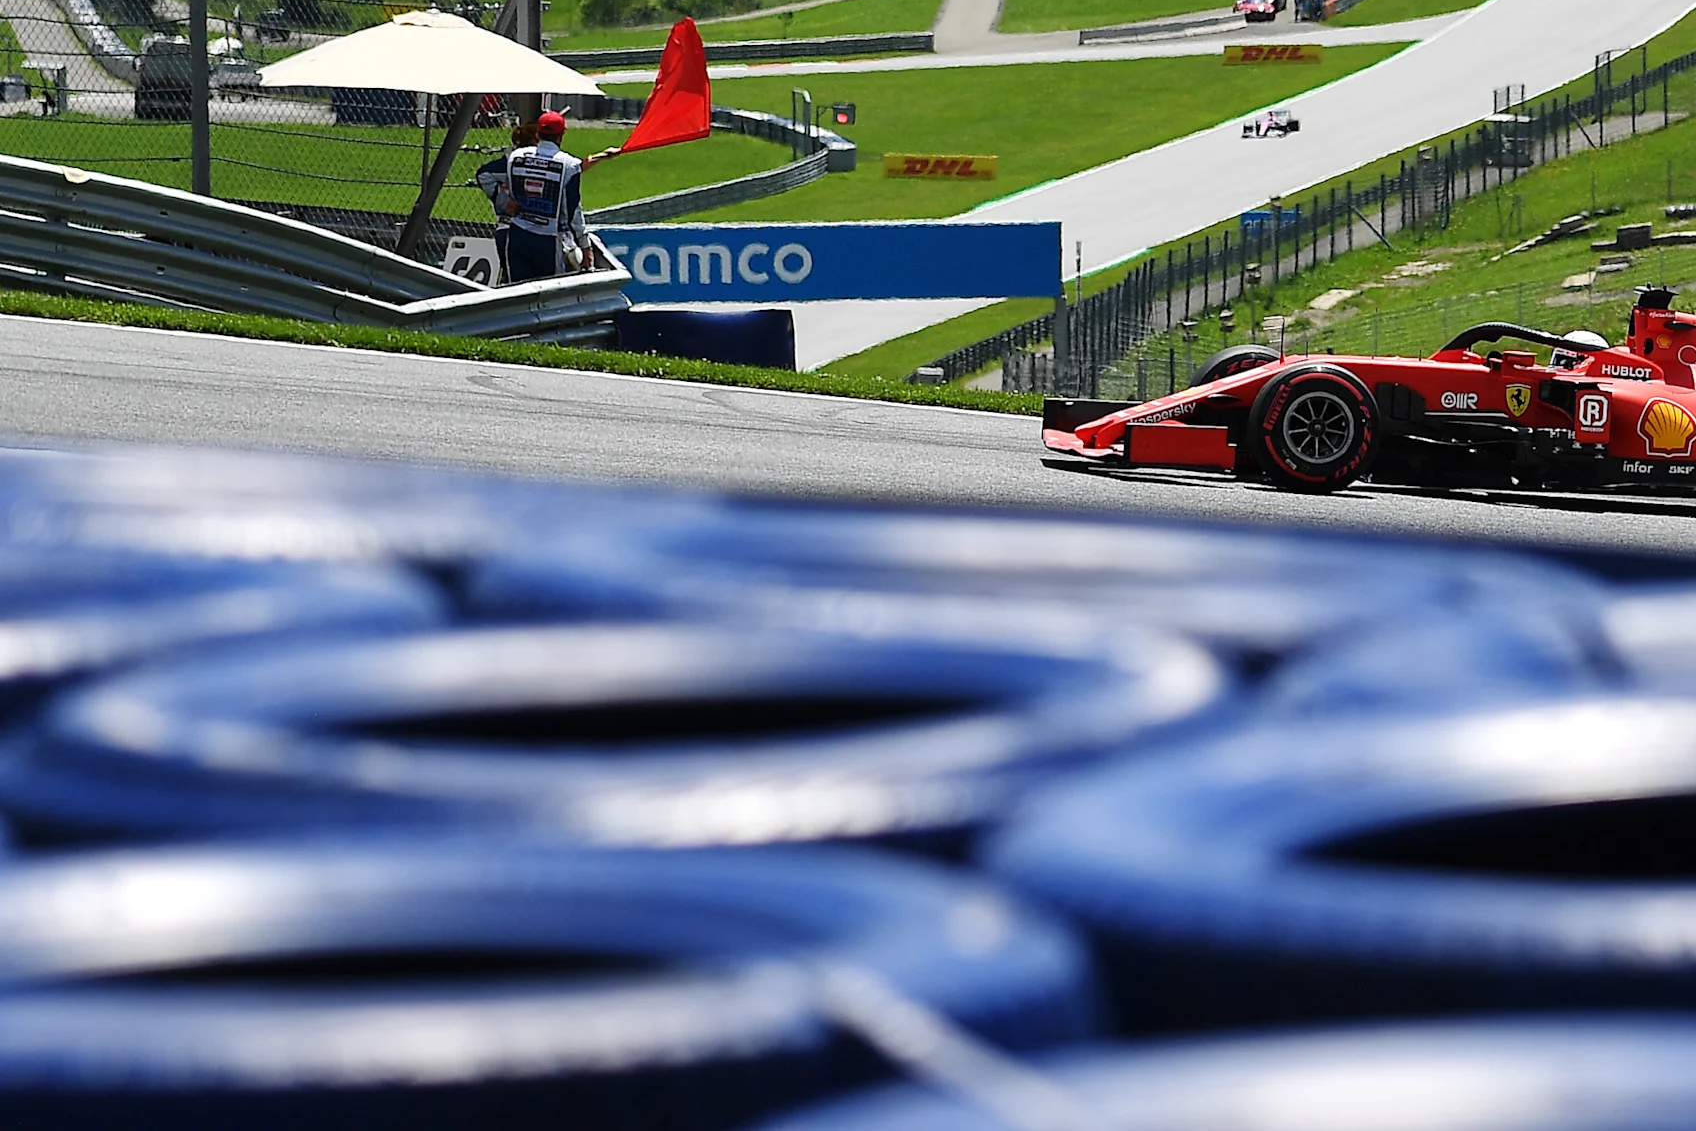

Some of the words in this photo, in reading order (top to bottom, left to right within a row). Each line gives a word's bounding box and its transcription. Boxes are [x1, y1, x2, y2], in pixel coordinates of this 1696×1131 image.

[1241, 46, 1306, 61] DHL
[902, 159, 977, 177] DHL
[1601, 364, 1652, 379] HUBLOT
[1622, 461, 1654, 474] infor
[1668, 465, 1695, 475] SKF
